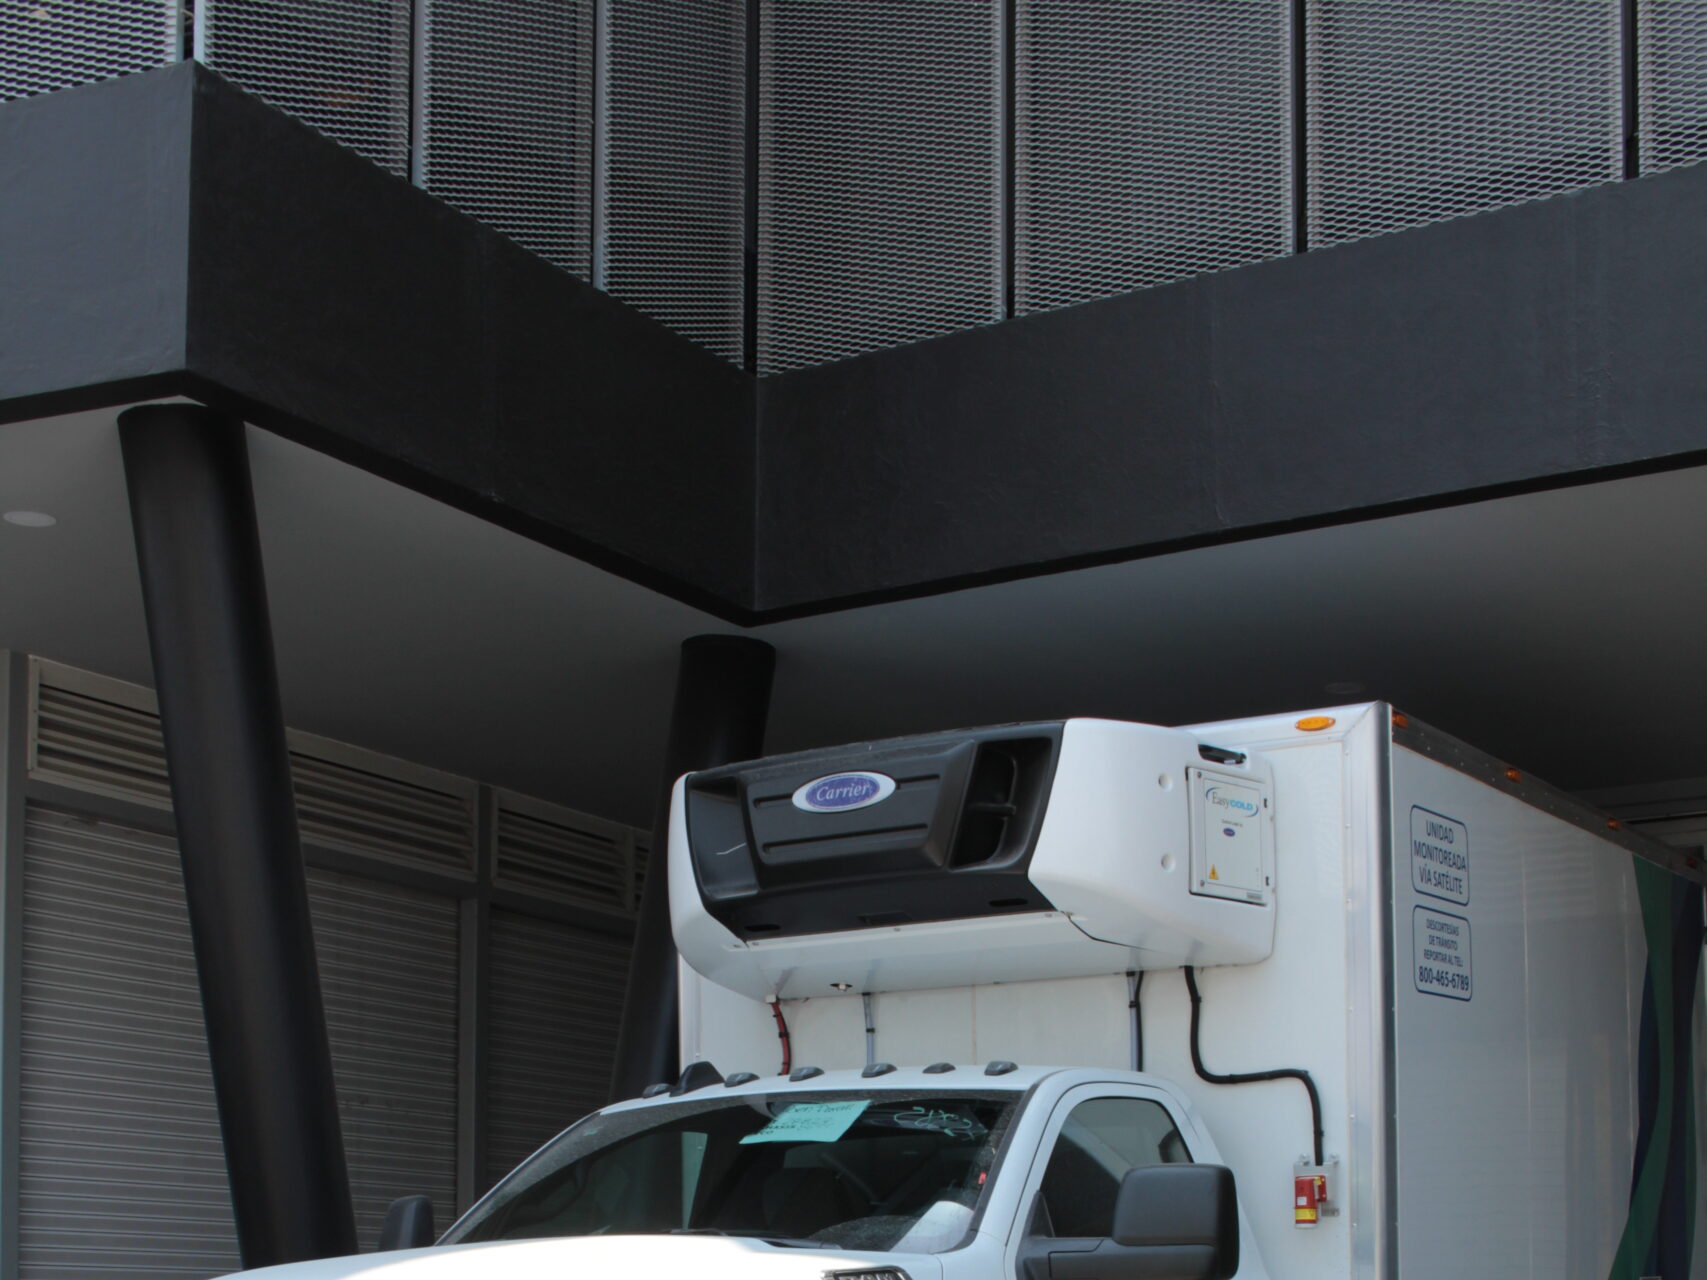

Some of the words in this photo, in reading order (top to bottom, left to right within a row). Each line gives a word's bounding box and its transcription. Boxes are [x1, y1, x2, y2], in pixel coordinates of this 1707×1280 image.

[816, 783, 870, 801] Carrier
[1426, 820, 1454, 844] UNIDAD
[1413, 840, 1467, 872] MONITOREADA
[1419, 863, 1432, 885] VÍA
[1433, 871, 1463, 895] SATÉLITE
[1419, 966, 1469, 991] 800-465-6789
